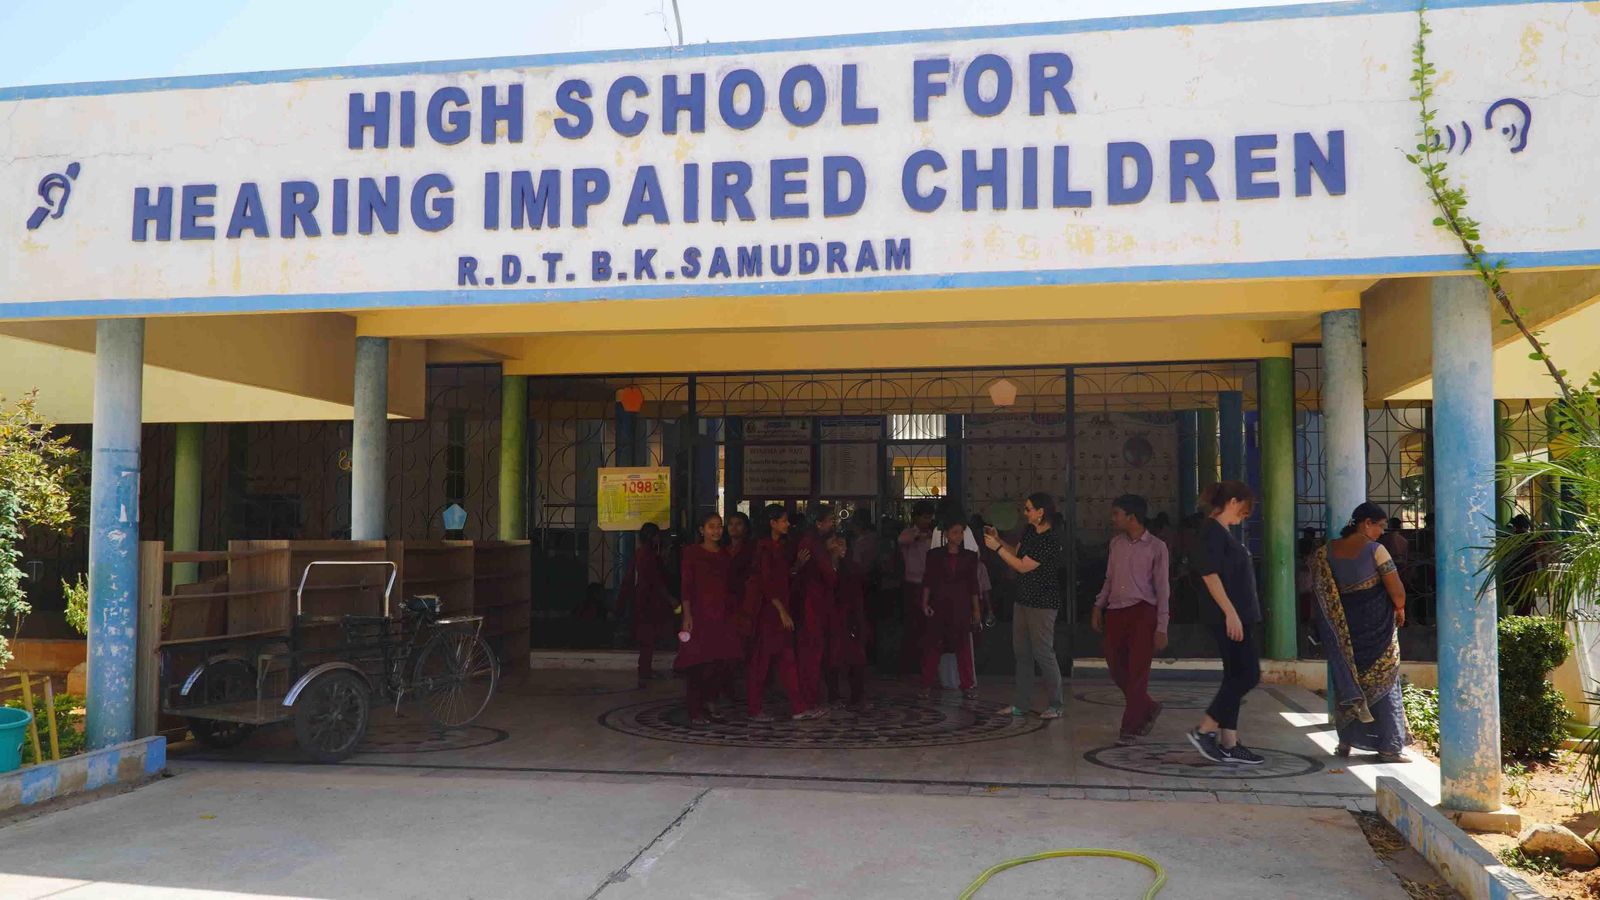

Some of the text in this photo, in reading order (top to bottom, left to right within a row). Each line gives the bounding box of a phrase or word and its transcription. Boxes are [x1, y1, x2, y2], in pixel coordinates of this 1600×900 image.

[349, 52, 1074, 148] HIGH SCHOOL FOR
[132, 130, 1346, 240] HEARING IMPAIRED CHILDREN
[457, 251, 576, 286] R.D.T.
[622, 481, 652, 494] 1098
